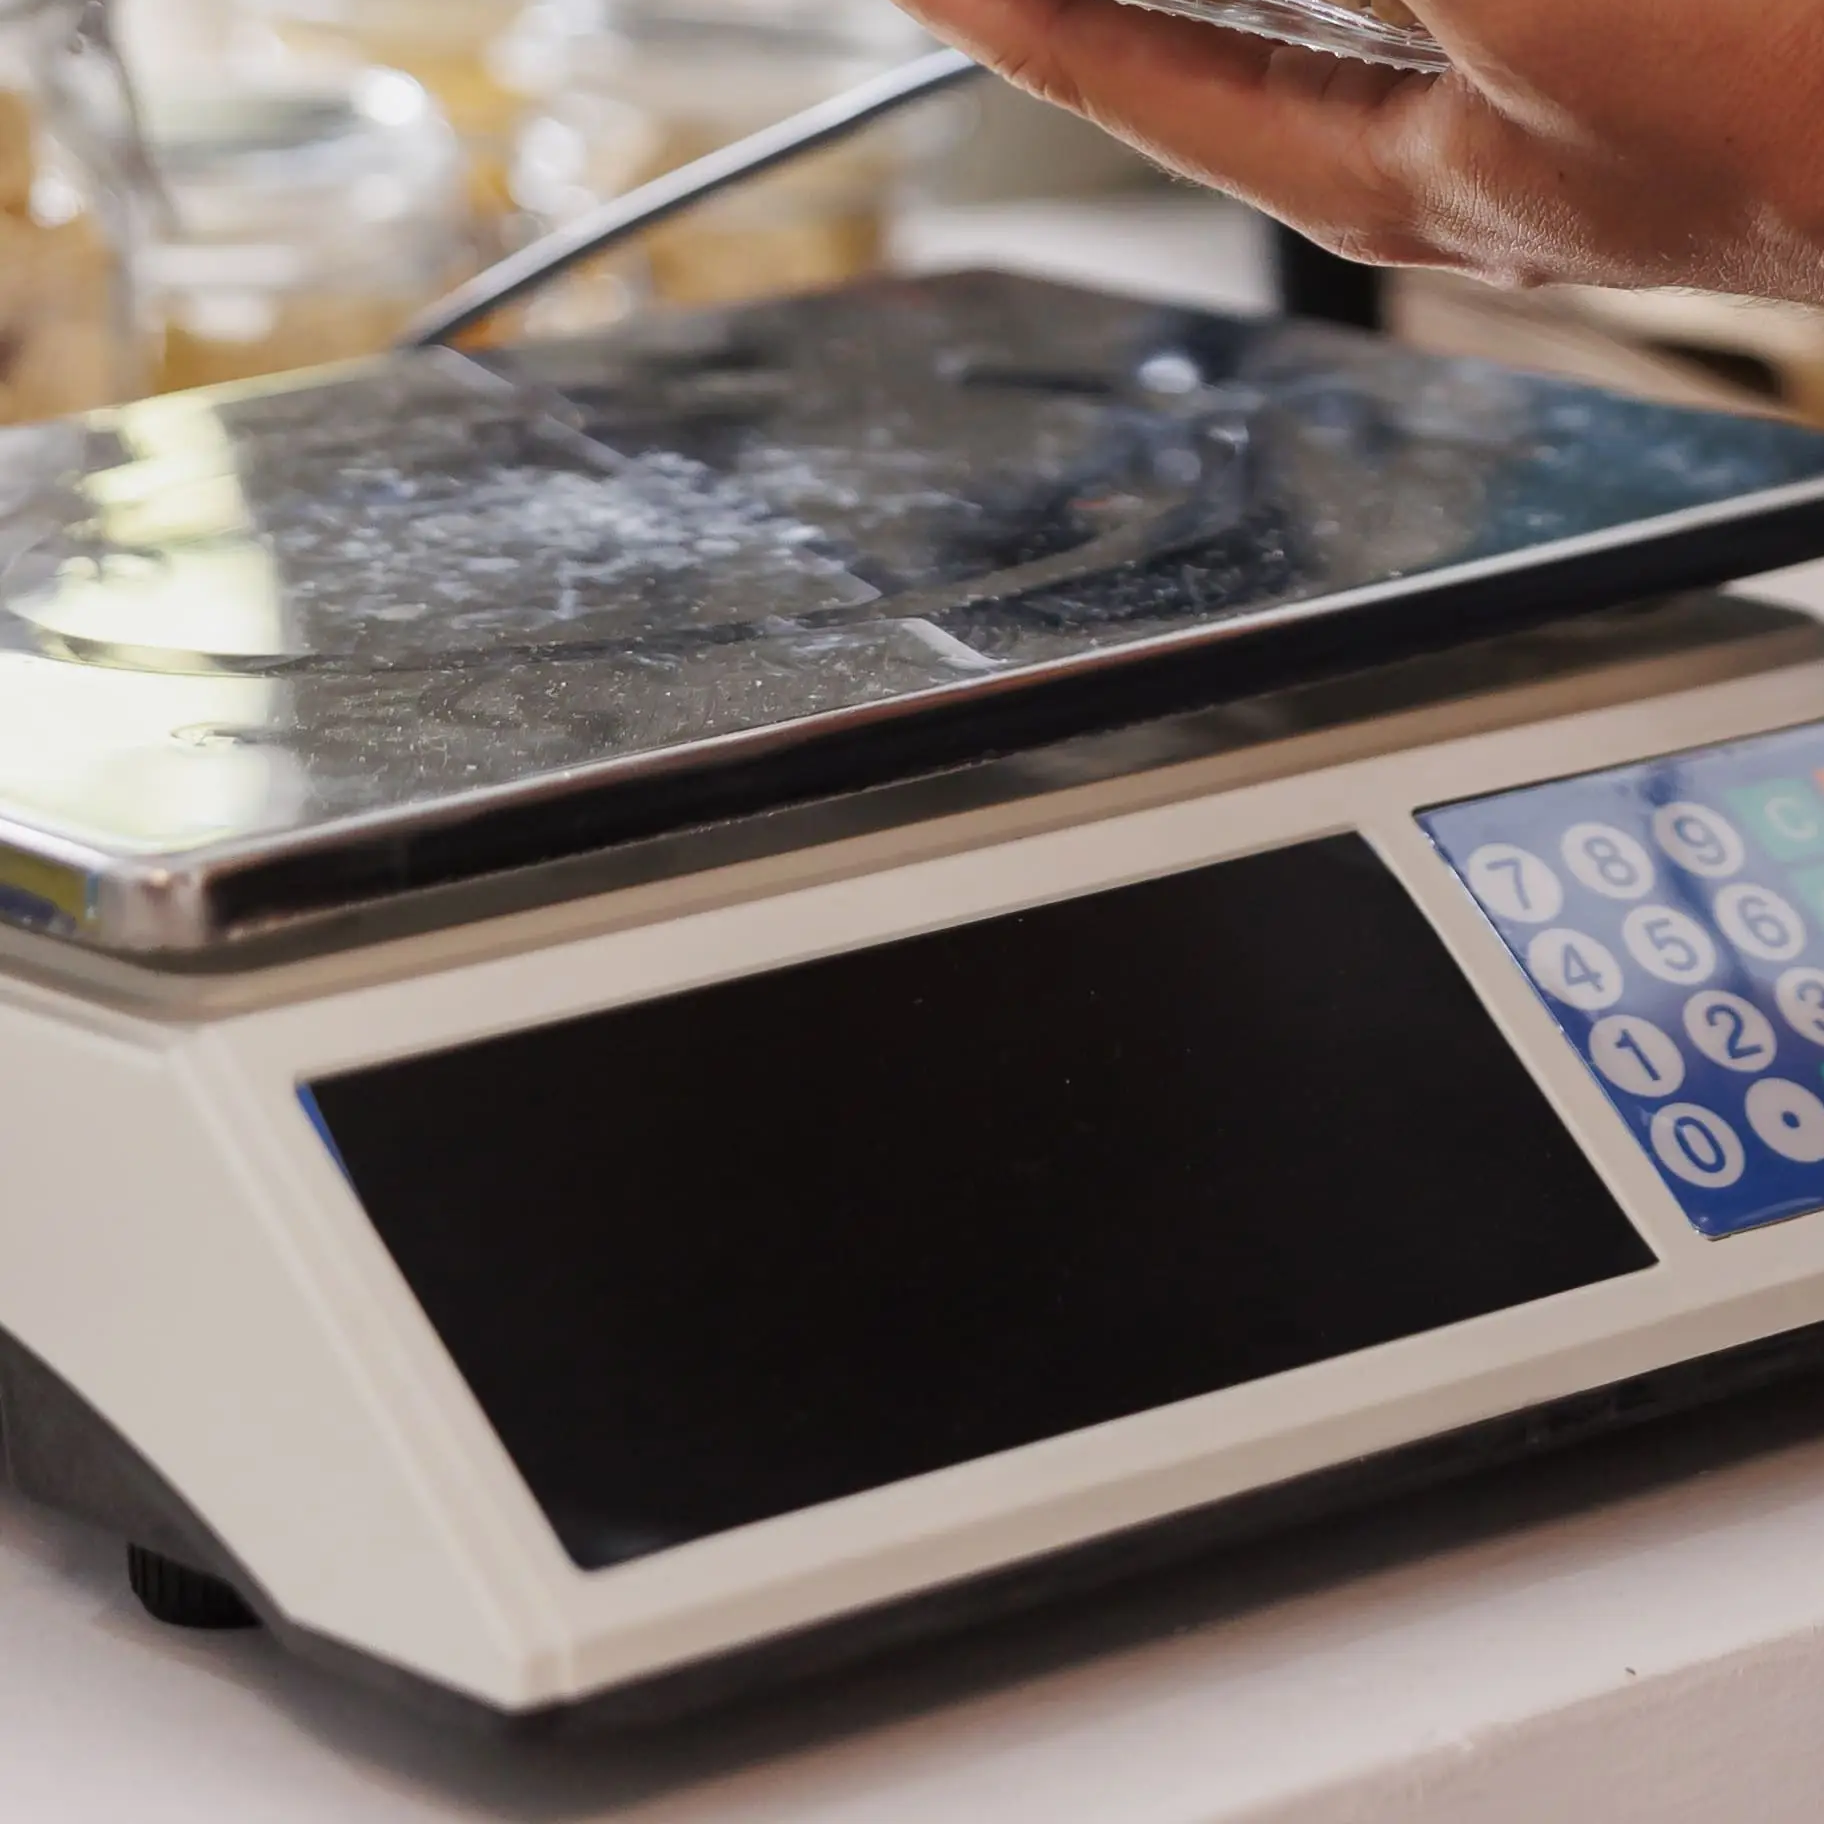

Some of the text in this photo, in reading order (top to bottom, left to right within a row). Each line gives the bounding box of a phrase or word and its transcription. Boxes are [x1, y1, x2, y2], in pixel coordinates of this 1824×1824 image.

[1486, 857, 1532, 911] 7
[1582, 835, 1639, 888] 8
[1673, 814, 1728, 867] 9
[1764, 797, 1818, 841] C
[1562, 942, 1605, 993] 4
[1643, 917, 1698, 972] 5
[1737, 896, 1790, 949] 6
[1614, 1029, 1661, 1081] 1
[1705, 1004, 1764, 1060] 2
[1673, 1116, 1726, 1173] 0
